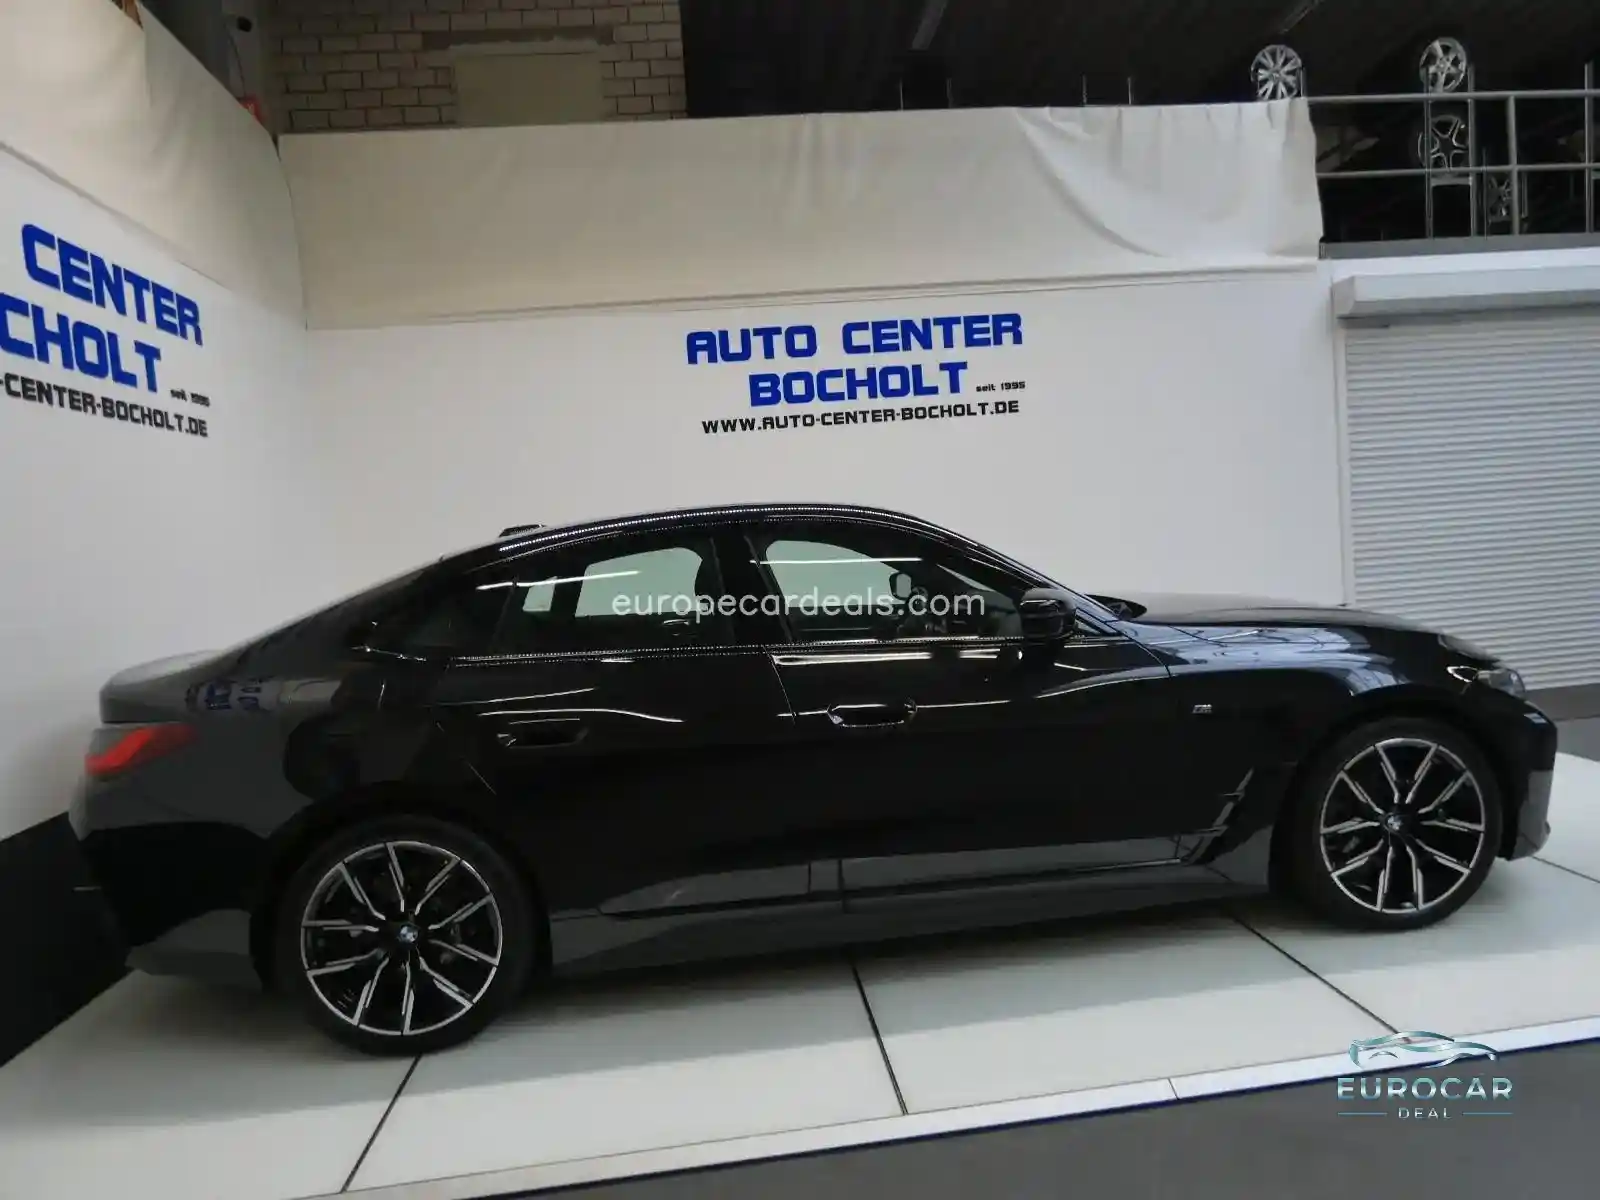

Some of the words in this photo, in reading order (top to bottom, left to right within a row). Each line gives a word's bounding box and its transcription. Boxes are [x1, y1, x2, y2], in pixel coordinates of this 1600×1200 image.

[21, 223, 203, 346] CENTER
[686, 325, 818, 364] AUTO
[842, 313, 1023, 354] CENTER
[749, 361, 968, 407] BOCHOLT
[976, 383, 995, 392] seit
[1001, 381, 1025, 391] 1995
[702, 400, 1020, 434] WWW.AUTO-CENTER-BOCHOLT.DE
